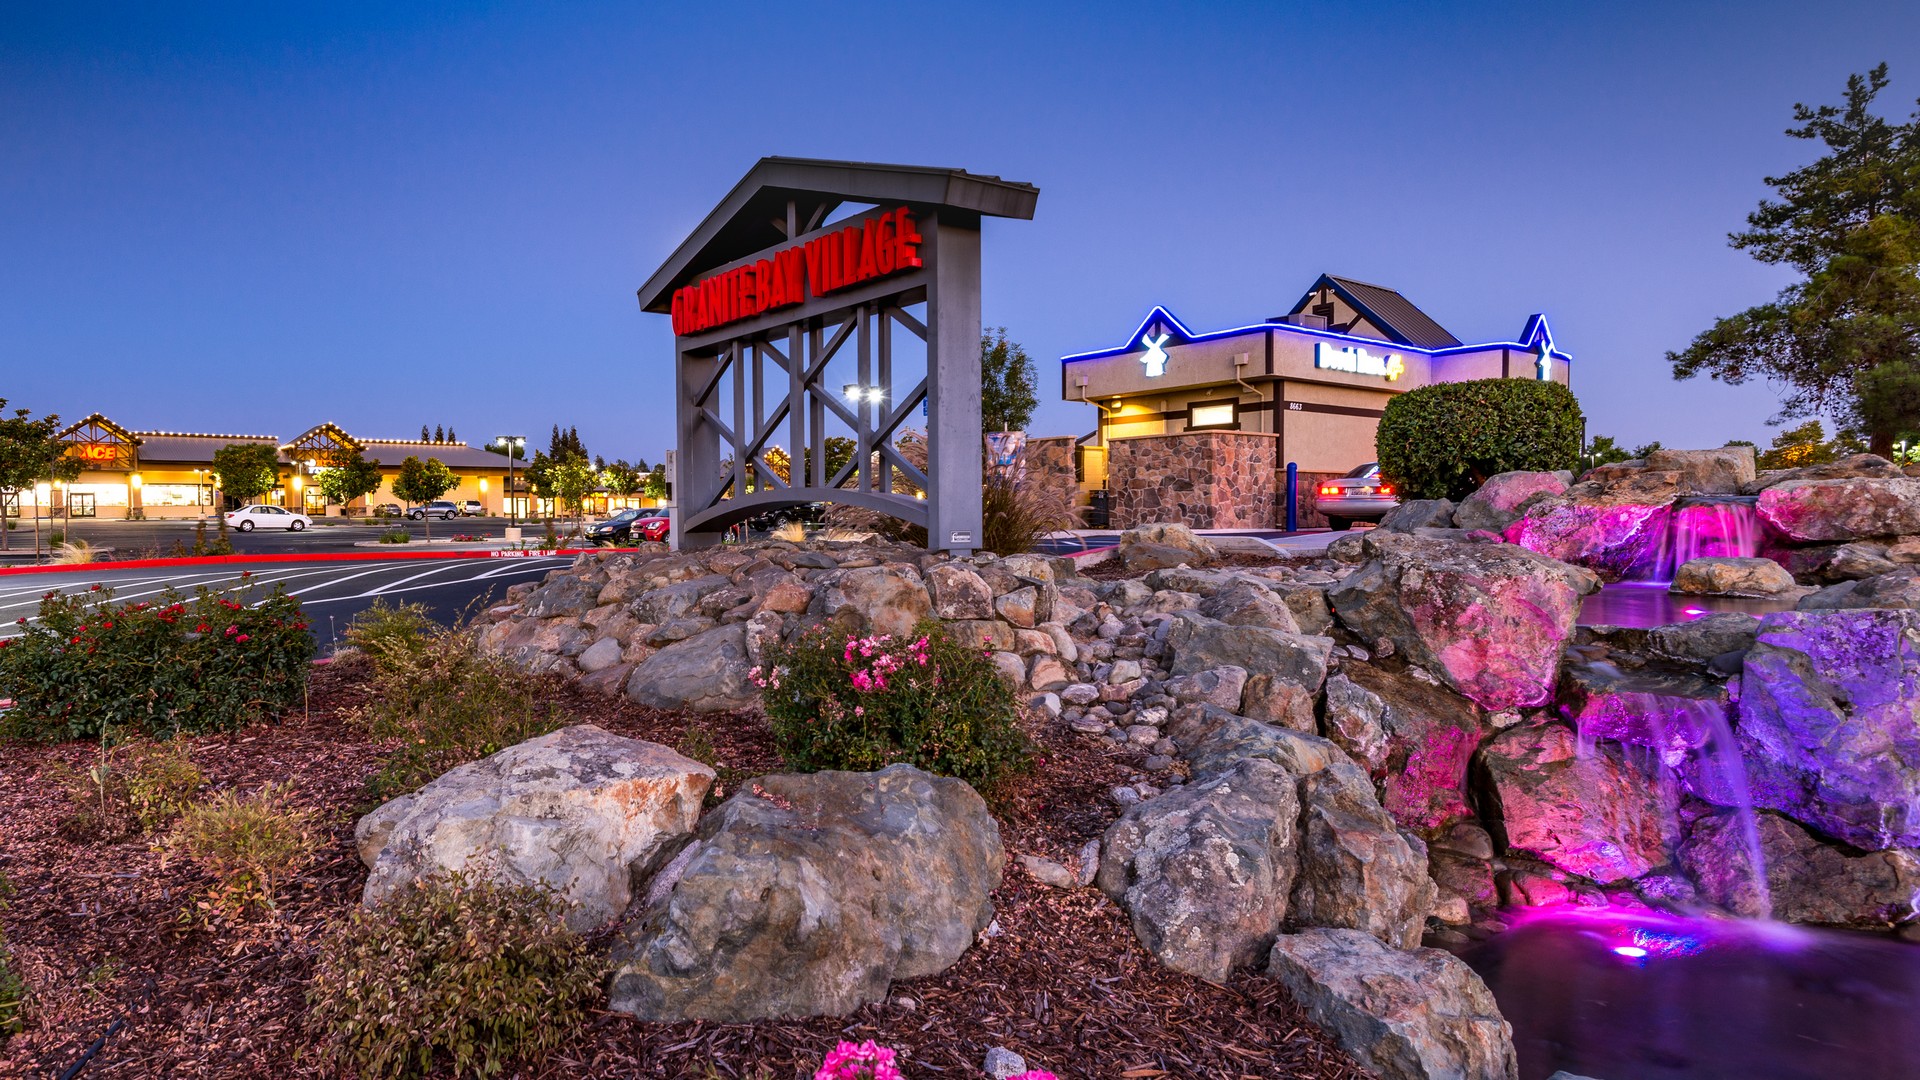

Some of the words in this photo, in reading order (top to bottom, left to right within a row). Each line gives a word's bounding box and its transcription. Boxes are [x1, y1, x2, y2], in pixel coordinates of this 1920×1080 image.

[671, 265, 757, 336] GRANITE
[756, 246, 804, 311] BAY
[805, 206, 922, 297] VILLAGE
[80, 443, 116, 460] ACE
